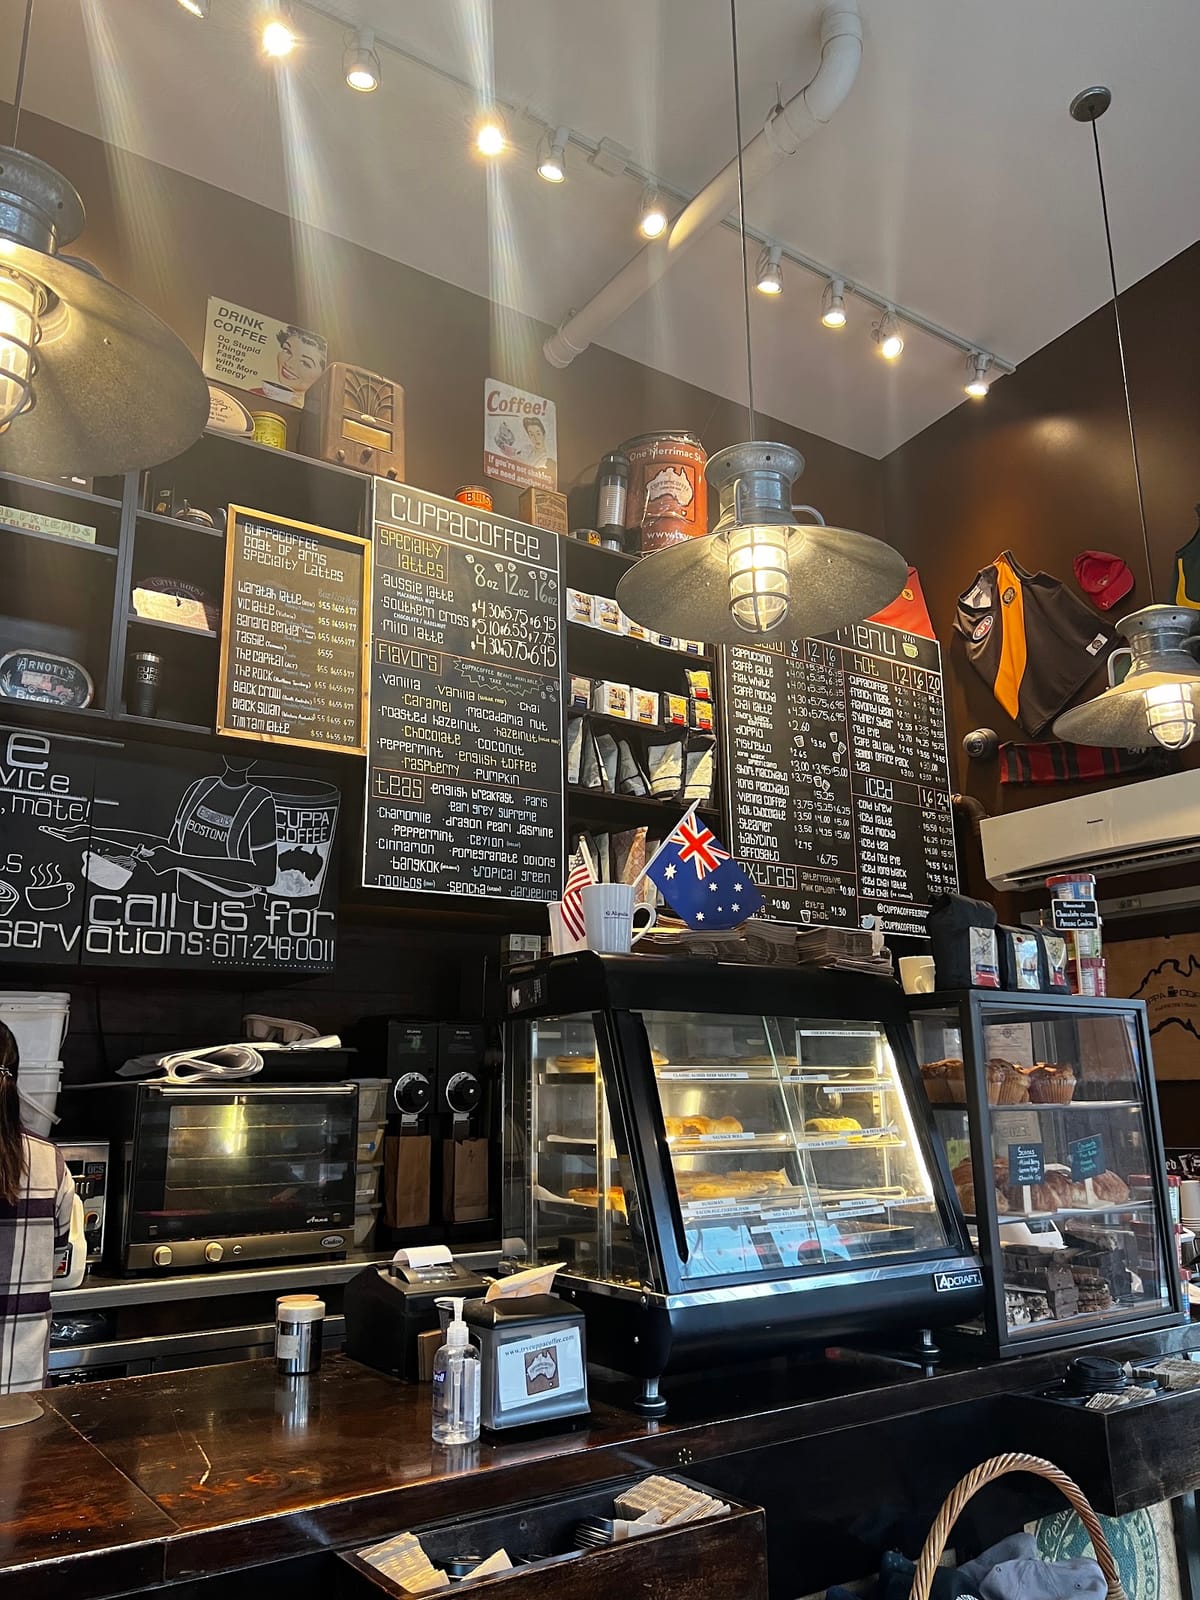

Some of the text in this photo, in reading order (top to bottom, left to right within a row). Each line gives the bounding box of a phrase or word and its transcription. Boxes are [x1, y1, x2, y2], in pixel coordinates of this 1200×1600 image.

[218, 307, 264, 330] DRINK
[214, 319, 268, 344] COFFEE
[217, 342, 246, 357] Things
[218, 335, 260, 355] Do Stupid
[217, 349, 244, 363] Faster
[216, 358, 258, 376] with More
[216, 364, 246, 380] Energy
[487, 390, 548, 416] Coffee!
[630, 447, 705, 465] One Merrimac St.
[487, 466, 516, 480] you need
[20, 512, 91, 536] FRIENDS
[391, 493, 541, 561] CUPPACOFFEE
[245, 522, 319, 551] CUPPACOFFEE
[238, 580, 277, 600] Waratah
[279, 590, 302, 605] latte
[251, 600, 275, 616] latte
[236, 613, 300, 637] Banana Bender
[235, 630, 264, 646] Tassie
[236, 647, 251, 661] The
[17, 657, 77, 680] ARNOTT'S
[234, 664, 251, 677] The
[382, 673, 421, 691] vanilla
[437, 684, 475, 701] vanilla
[381, 705, 481, 733] roasted hazelnut
[404, 693, 548, 732] caramel macadamia nut
[404, 725, 538, 746] chocolate hazelnut
[379, 737, 444, 758] peppermint
[458, 750, 497, 766] english
[477, 738, 525, 756] coconut
[404, 756, 460, 776] raspberry
[432, 783, 468, 798] english
[471, 788, 515, 804] breakfast
[11, 795, 91, 823] mate!
[276, 809, 330, 828] CUPPA
[450, 801, 537, 822] earl grey supreme
[378, 807, 431, 824] chamomile
[445, 816, 482, 830] dragon
[486, 820, 512, 833] pearl
[276, 825, 328, 844] COFFEE
[393, 825, 455, 843] peppermint
[469, 834, 504, 848] ceylon
[378, 838, 556, 868] cinnamon pomegranate oolong
[378, 874, 422, 889] rooibos
[449, 881, 486, 895] sencha
[472, 866, 517, 881] tropical
[521, 870, 551, 883] green
[88, 892, 336, 938] call us for
[940, 1274, 978, 1288] ADCRAFT
